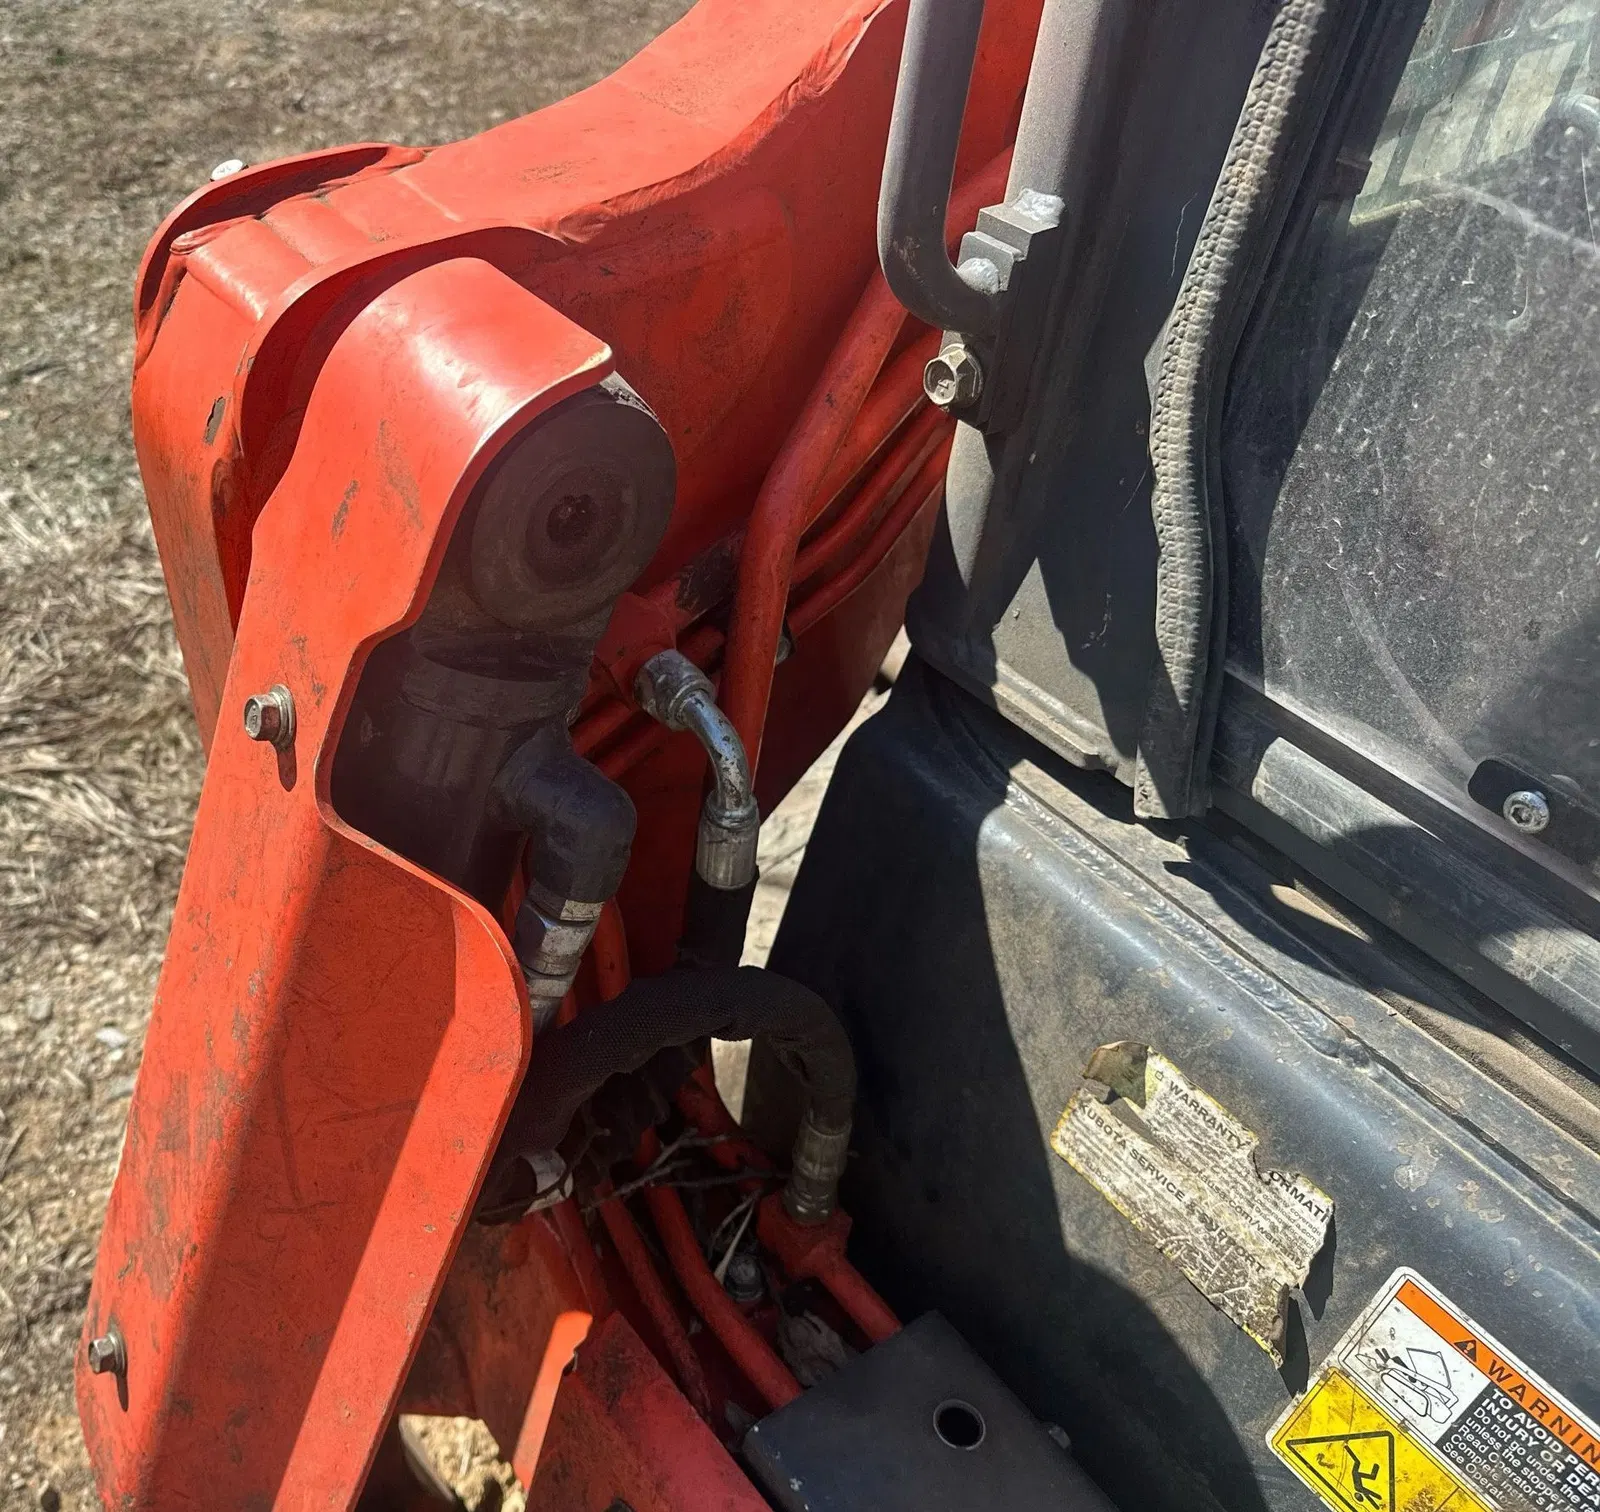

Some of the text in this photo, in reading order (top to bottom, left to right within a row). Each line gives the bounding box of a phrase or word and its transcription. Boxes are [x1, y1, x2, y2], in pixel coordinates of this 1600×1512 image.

[1080, 1101, 1127, 1149] KUBOTA
[1130, 1149, 1186, 1201] SERVICE
[1169, 1081, 1250, 1149] WARRANTY
[1443, 1442, 1464, 1464] See
[1451, 1434, 1499, 1480] Complete
[1474, 1407, 1491, 1424] Do
[1491, 1424, 1512, 1442] not
[1509, 1441, 1526, 1455] go
[1526, 1454, 1561, 1485] under
[1560, 1484, 1580, 1503] the
[1482, 1399, 1540, 1447] INJURY
[1540, 1450, 1566, 1473] OR
[1492, 1389, 1513, 1410] TO
[1514, 1413, 1563, 1453] AVOID
[1458, 1425, 1489, 1453] Read
[1488, 1452, 1545, 1506] Operator's
[1466, 1418, 1502, 1450] unless
[1502, 1449, 1521, 1467] the
[1521, 1467, 1566, 1505] stopper
